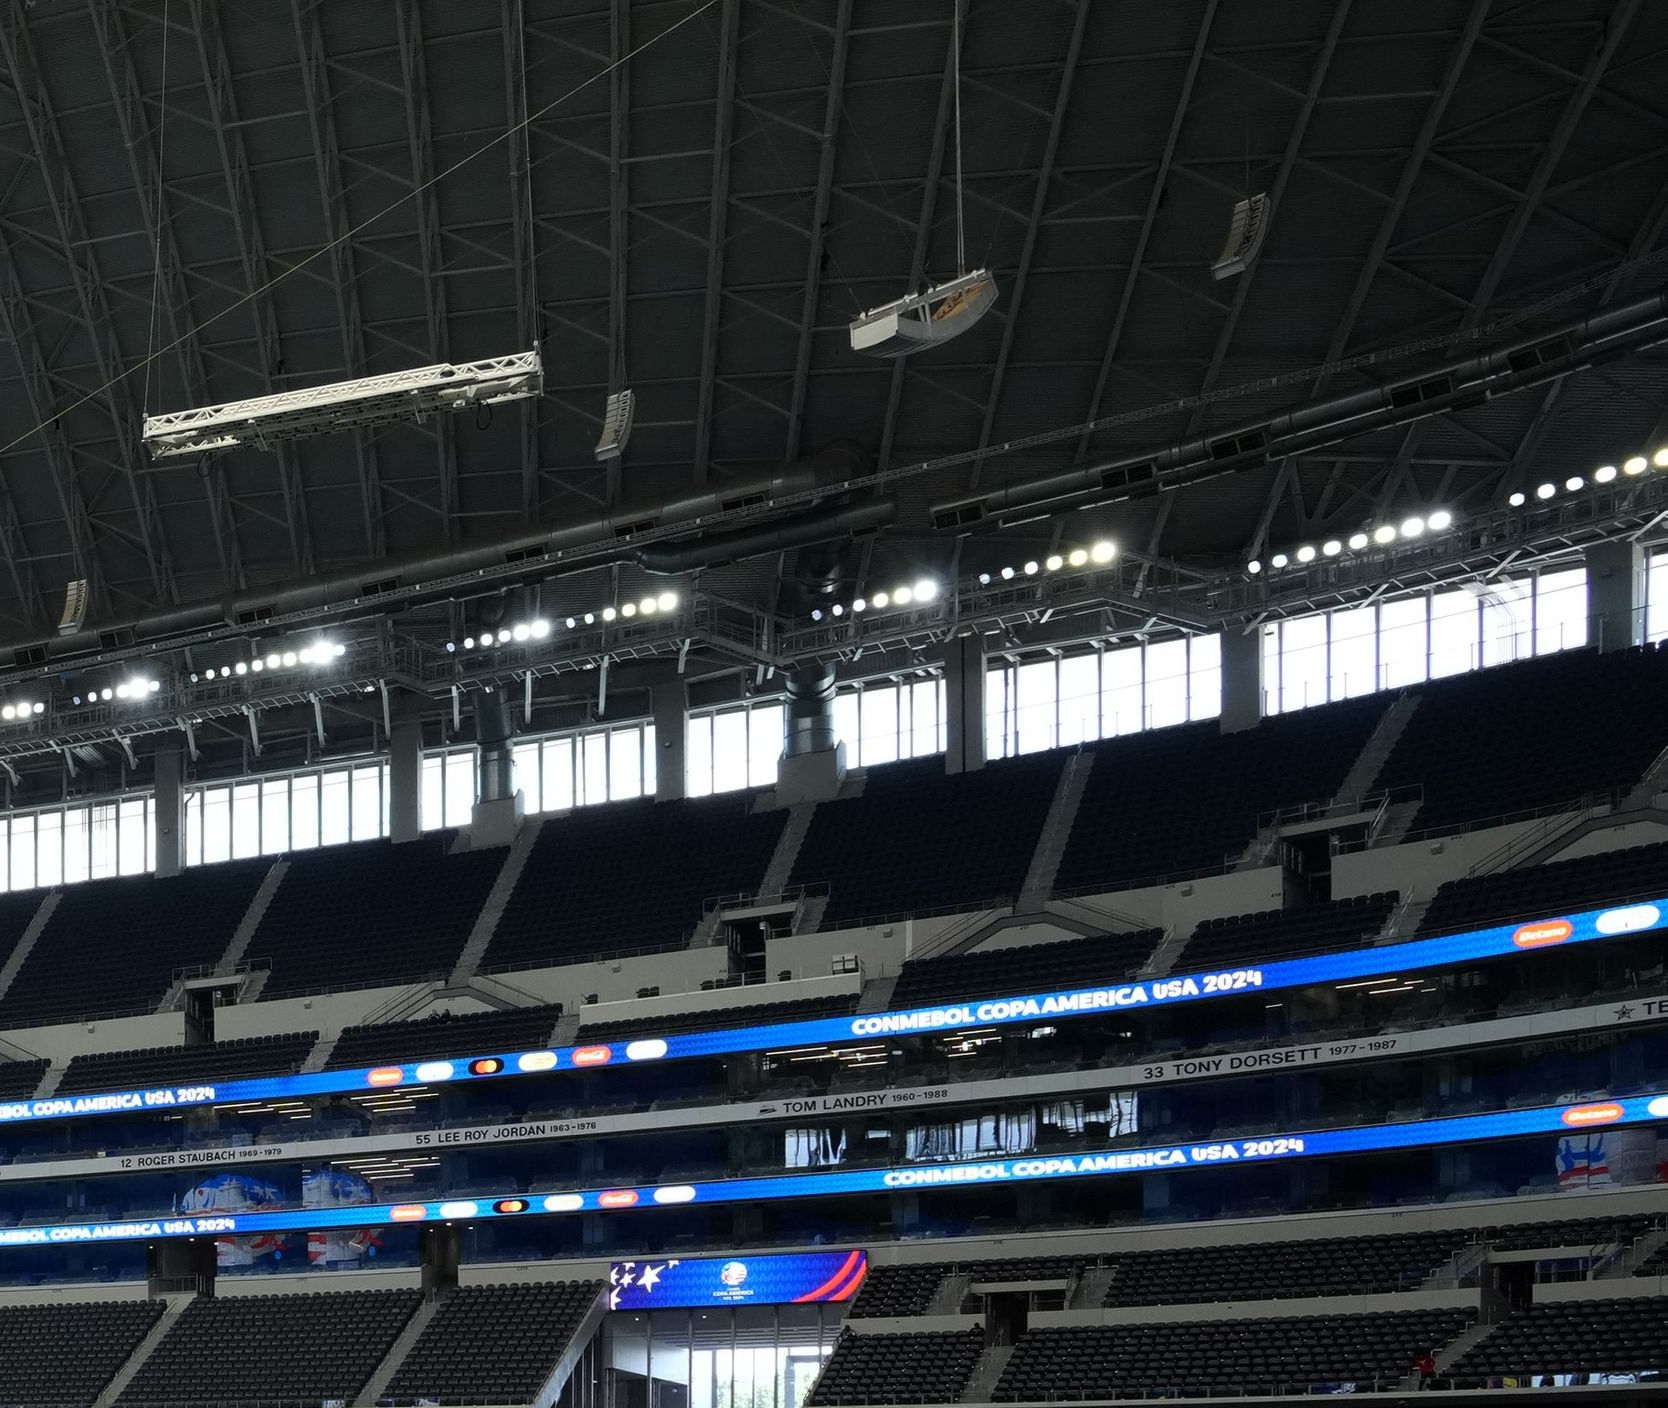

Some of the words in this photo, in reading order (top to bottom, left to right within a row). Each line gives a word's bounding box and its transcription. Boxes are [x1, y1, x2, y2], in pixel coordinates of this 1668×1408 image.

[851, 1008, 975, 1034] CONMEBOL
[977, 999, 1040, 1020] COPA
[1040, 987, 1148, 1013] AMERICA
[1152, 978, 1199, 999] USA
[1203, 970, 1262, 992] 2024
[1143, 1065, 1164, 1080] 33
[1172, 1058, 1223, 1076] TONY
[1229, 1046, 1322, 1069] DORSETT
[782, 1100, 816, 1113] TOM
[822, 1093, 887, 1110] LANDRY
[415, 1133, 431, 1145] 55
[437, 1131, 460, 1144] LEE
[464, 1129, 489, 1141] ROY
[492, 1124, 545, 1139] JORDAN
[120, 1157, 132, 1168] 12
[137, 1154, 175, 1167] ROGER
[178, 1150, 235, 1164] STAUBACH
[883, 1164, 1010, 1185] CONMEBOL
[1012, 1159, 1077, 1176] COPA
[1077, 1150, 1186, 1171] AMERICA
[1191, 1144, 1239, 1161] USA
[1243, 1138, 1304, 1156] 2024
